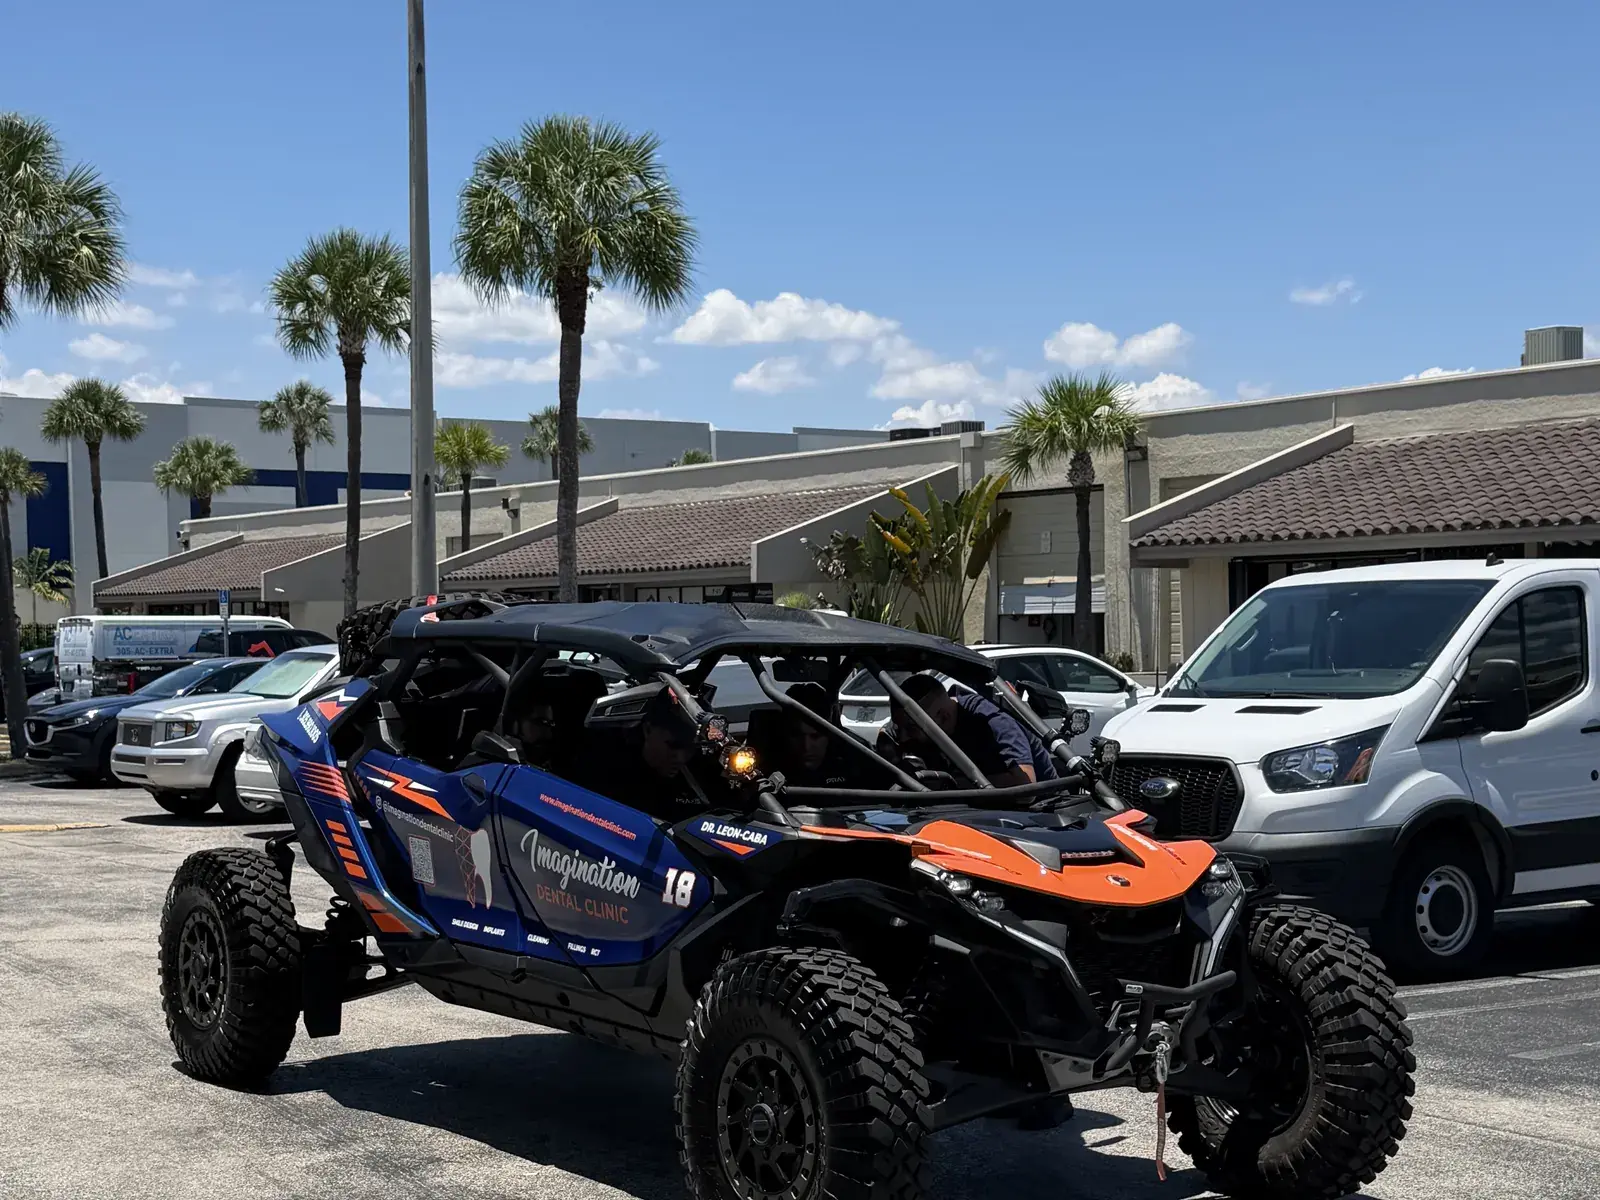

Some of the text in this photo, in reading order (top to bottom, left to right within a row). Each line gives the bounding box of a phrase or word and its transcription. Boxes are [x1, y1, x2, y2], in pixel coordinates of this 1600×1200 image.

[113, 626, 132, 641] AC
[116, 646, 175, 656] 305-AC-EXTRA
[382, 800, 454, 843] @imaginationdentalclinic
[539, 793, 637, 841] www.imaginationdentalclinic.com
[700, 821, 768, 846] DR. LEON-CABA
[520, 828, 641, 899] Imagination
[536, 883, 629, 924] DENTAL CLINIC
[662, 867, 696, 908] 18
[527, 933, 550, 945] CLEANING
[567, 942, 587, 954] FILLINGS
